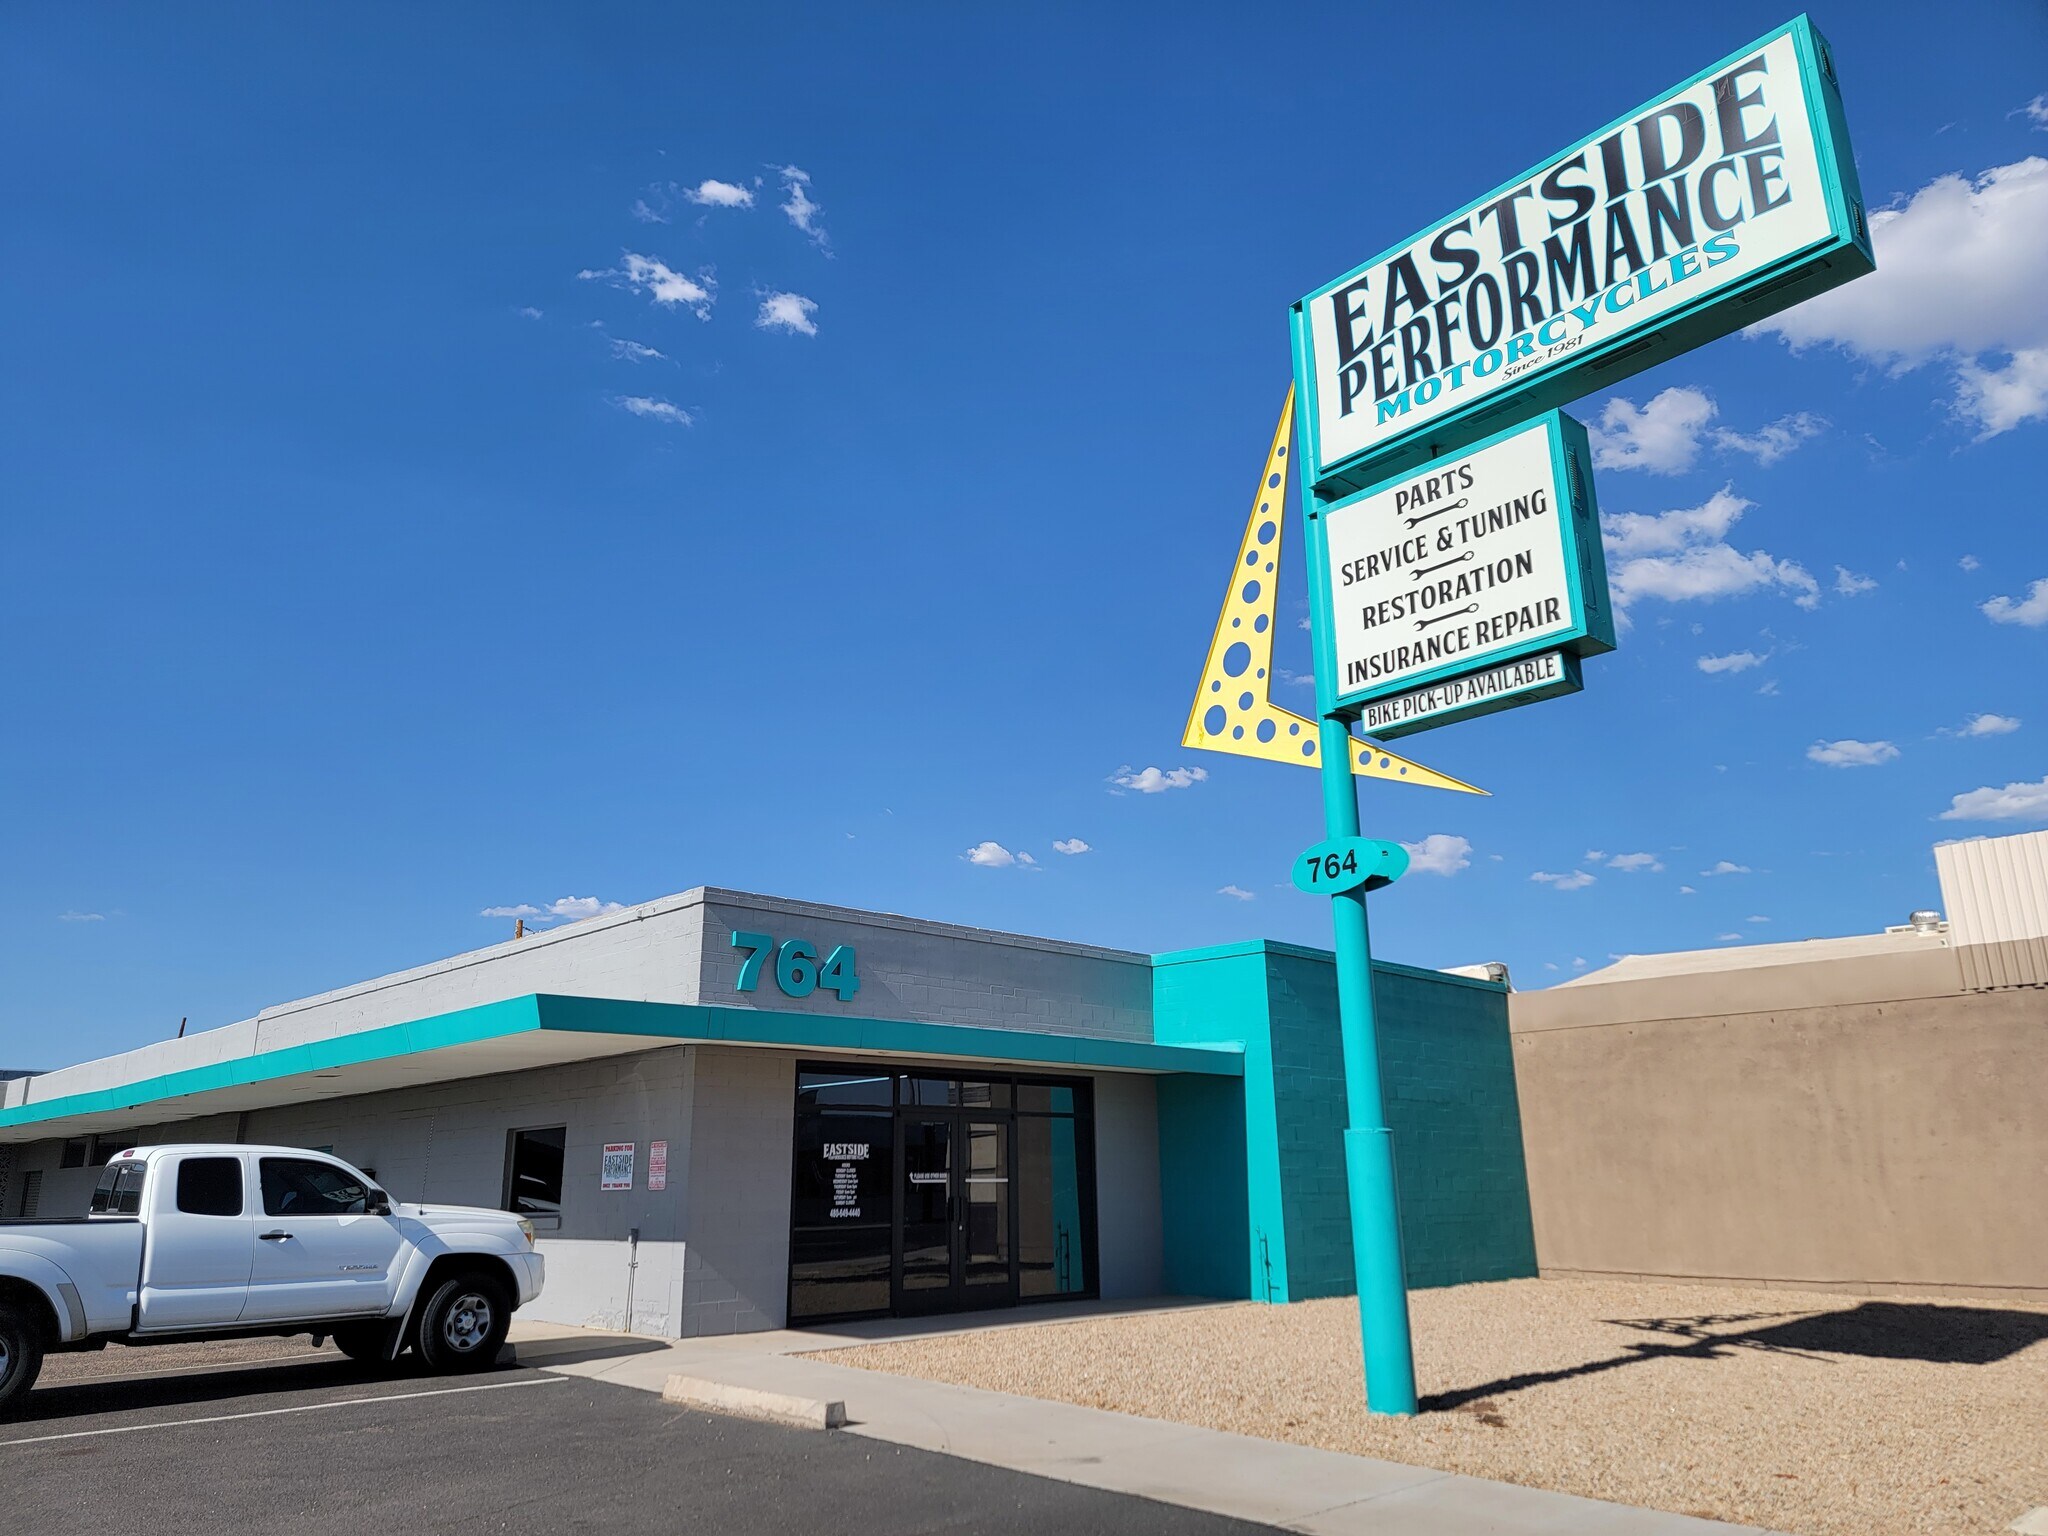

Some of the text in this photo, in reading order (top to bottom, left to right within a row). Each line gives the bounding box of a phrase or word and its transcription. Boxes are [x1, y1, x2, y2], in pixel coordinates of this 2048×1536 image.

[1330, 53, 1780, 370] EASTSIDE
[1338, 147, 1793, 419] PERFORMANCE
[1376, 230, 1741, 426] MOTORCYCLES
[1501, 333, 1584, 381] Since 1981
[1395, 463, 1475, 515] PARTS
[1341, 488, 1548, 587] SERVICE & TUNING
[1362, 549, 1534, 630] RESTORATION
[1347, 596, 1562, 686] INSURANCE REPAIR
[1368, 656, 1556, 727] BIKE PICK-UP AVAILABLE
[1307, 849, 1357, 883] 764
[731, 930, 861, 1002] 764
[604, 1154, 632, 1166] EASTSIDE
[823, 1143, 870, 1159] EASTSIDE
